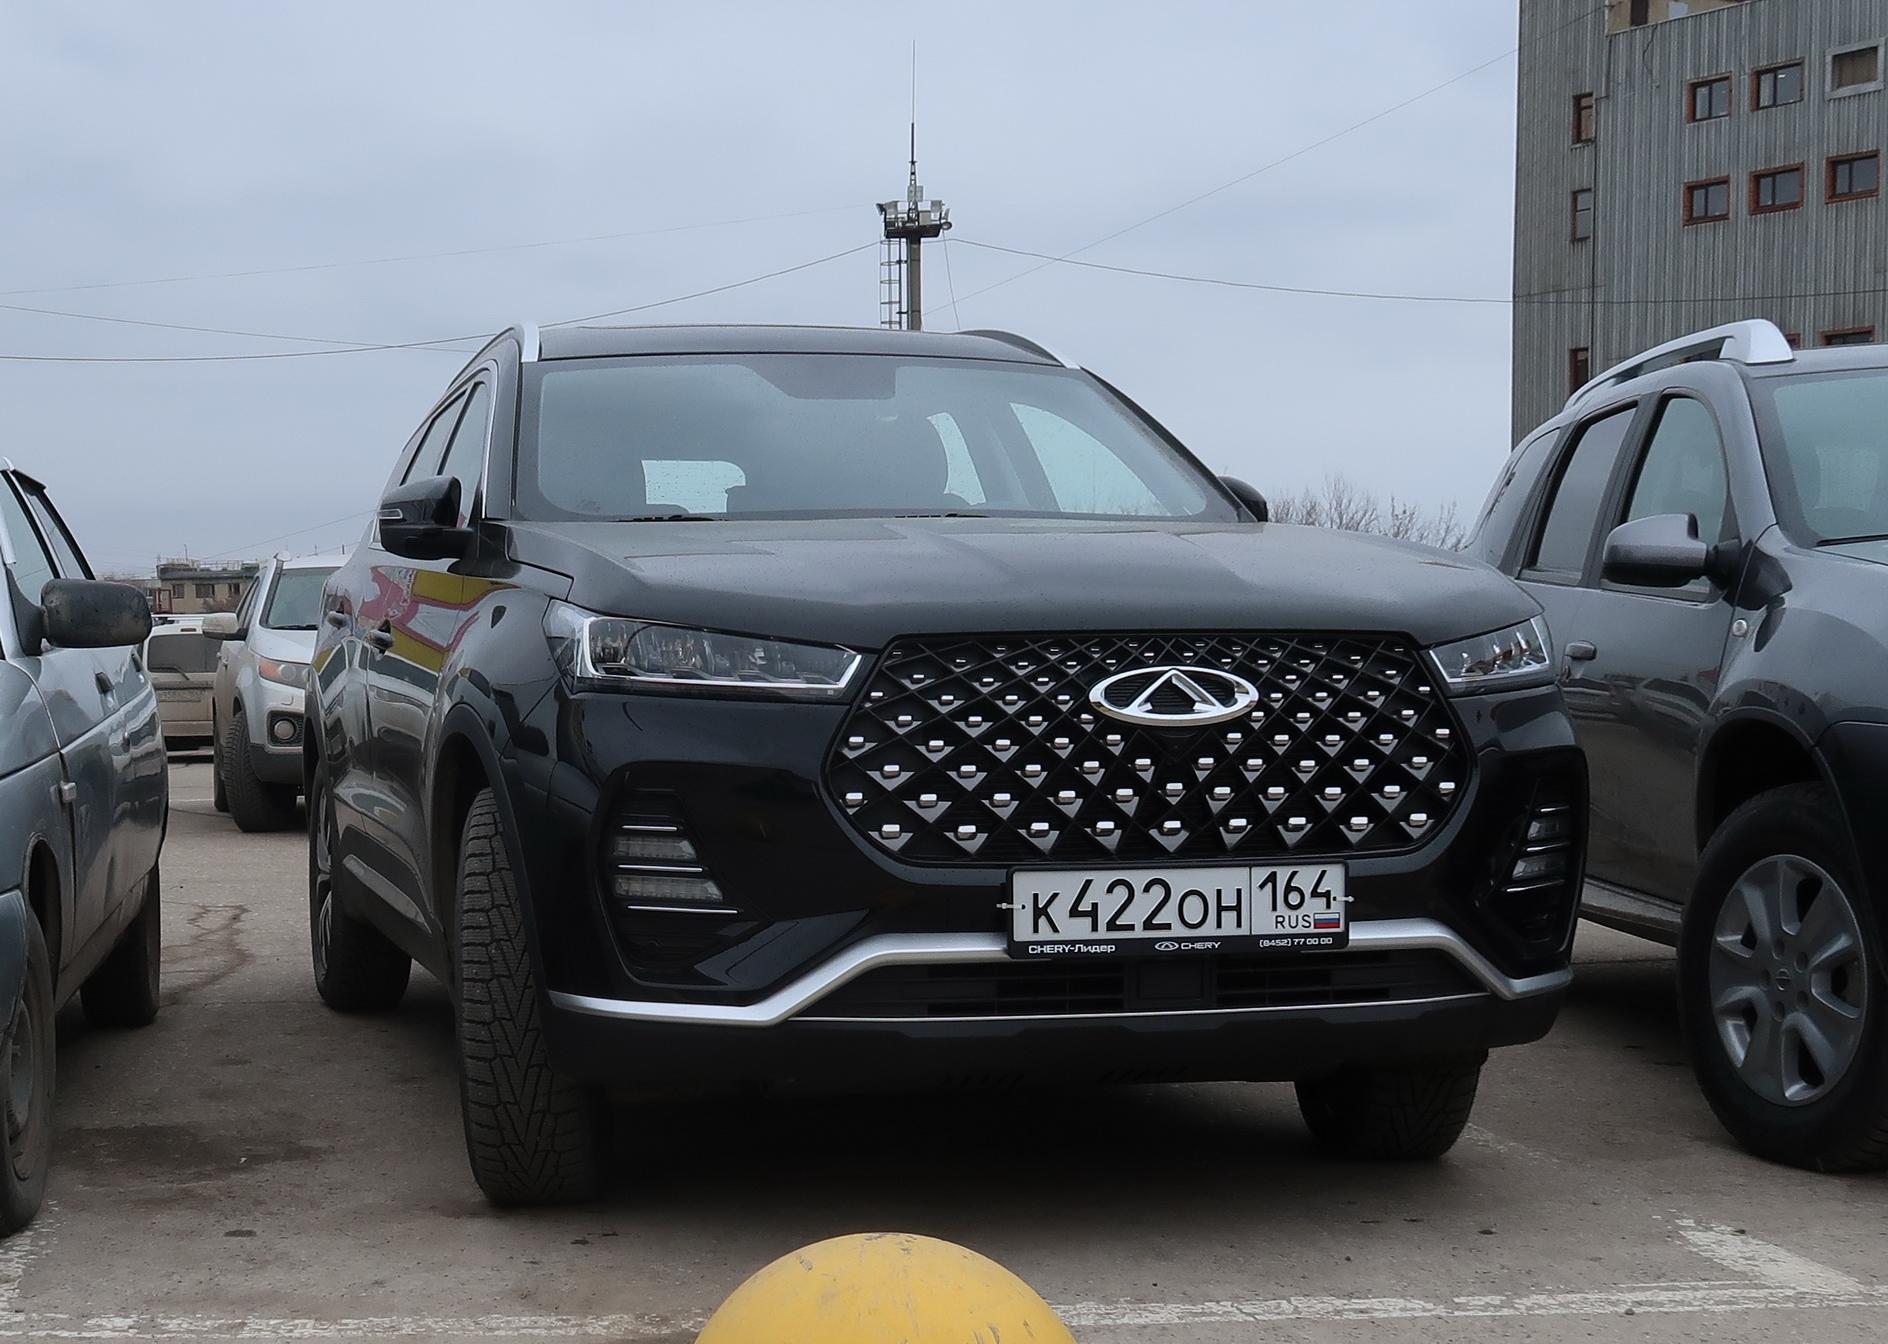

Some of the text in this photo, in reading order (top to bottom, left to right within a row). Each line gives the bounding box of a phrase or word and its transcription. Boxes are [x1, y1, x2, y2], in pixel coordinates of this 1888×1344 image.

[1257, 870, 1332, 912] 164
[1275, 914, 1312, 929] RUS
[1180, 941, 1222, 950] CHERY
[1320, 937, 1333, 945] 00
[1028, 944, 1116, 954] CHERY-Лидер
